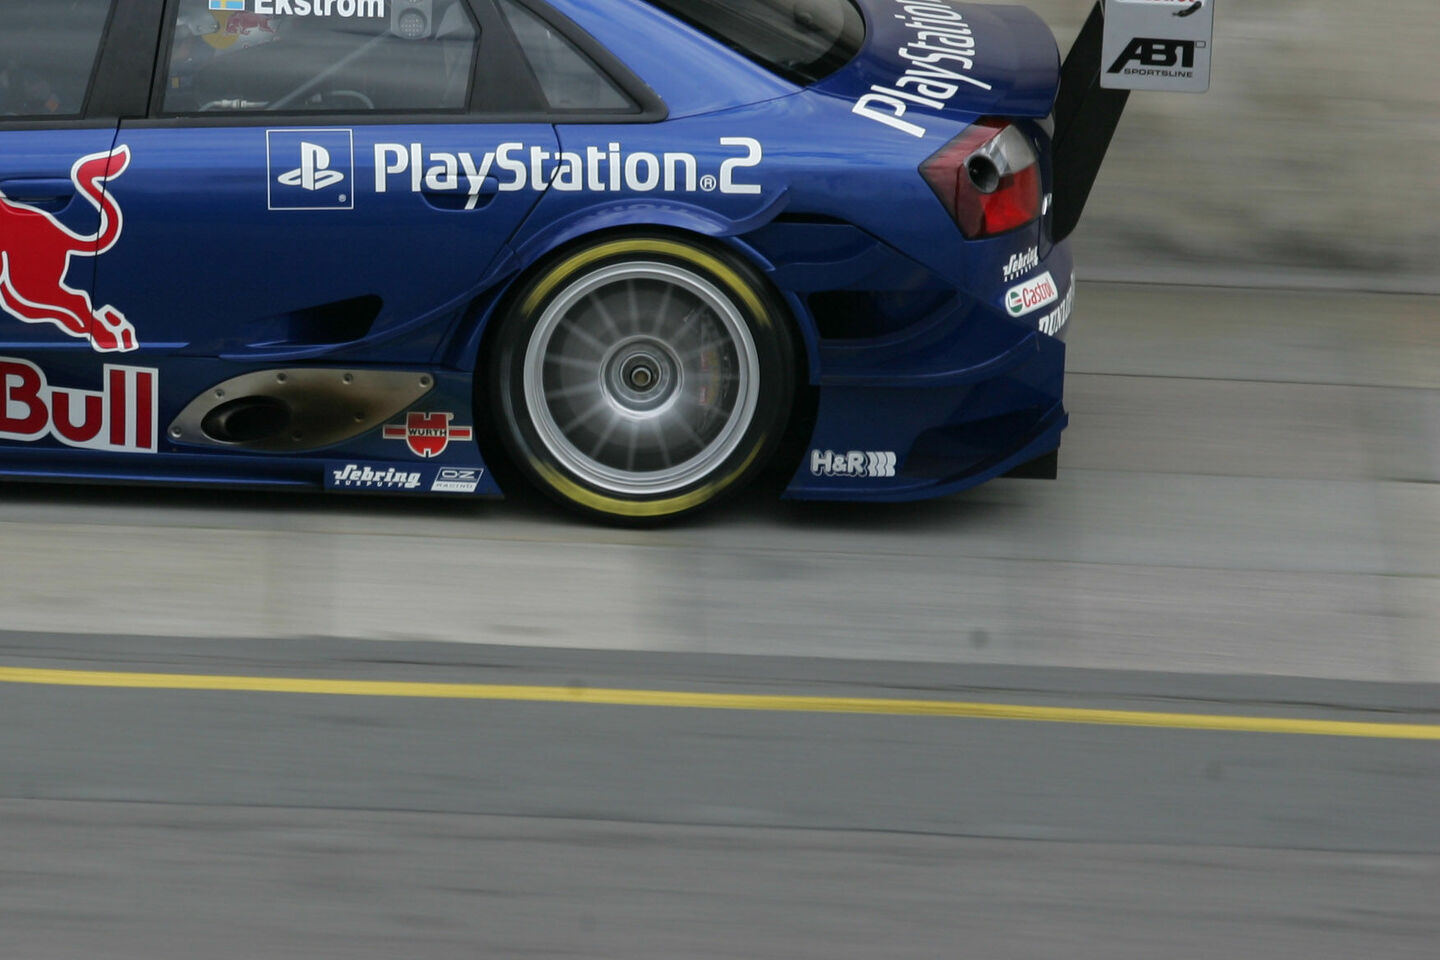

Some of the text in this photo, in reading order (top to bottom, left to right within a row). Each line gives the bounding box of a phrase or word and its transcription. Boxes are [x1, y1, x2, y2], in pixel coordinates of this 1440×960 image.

[1106, 37, 1194, 74] ABT
[1124, 68, 1193, 78] SPORTSLINE
[374, 142, 697, 210] PlayStation
[720, 137, 762, 194] 2
[1022, 277, 1054, 308] Castrol
[810, 449, 868, 477] H&R
